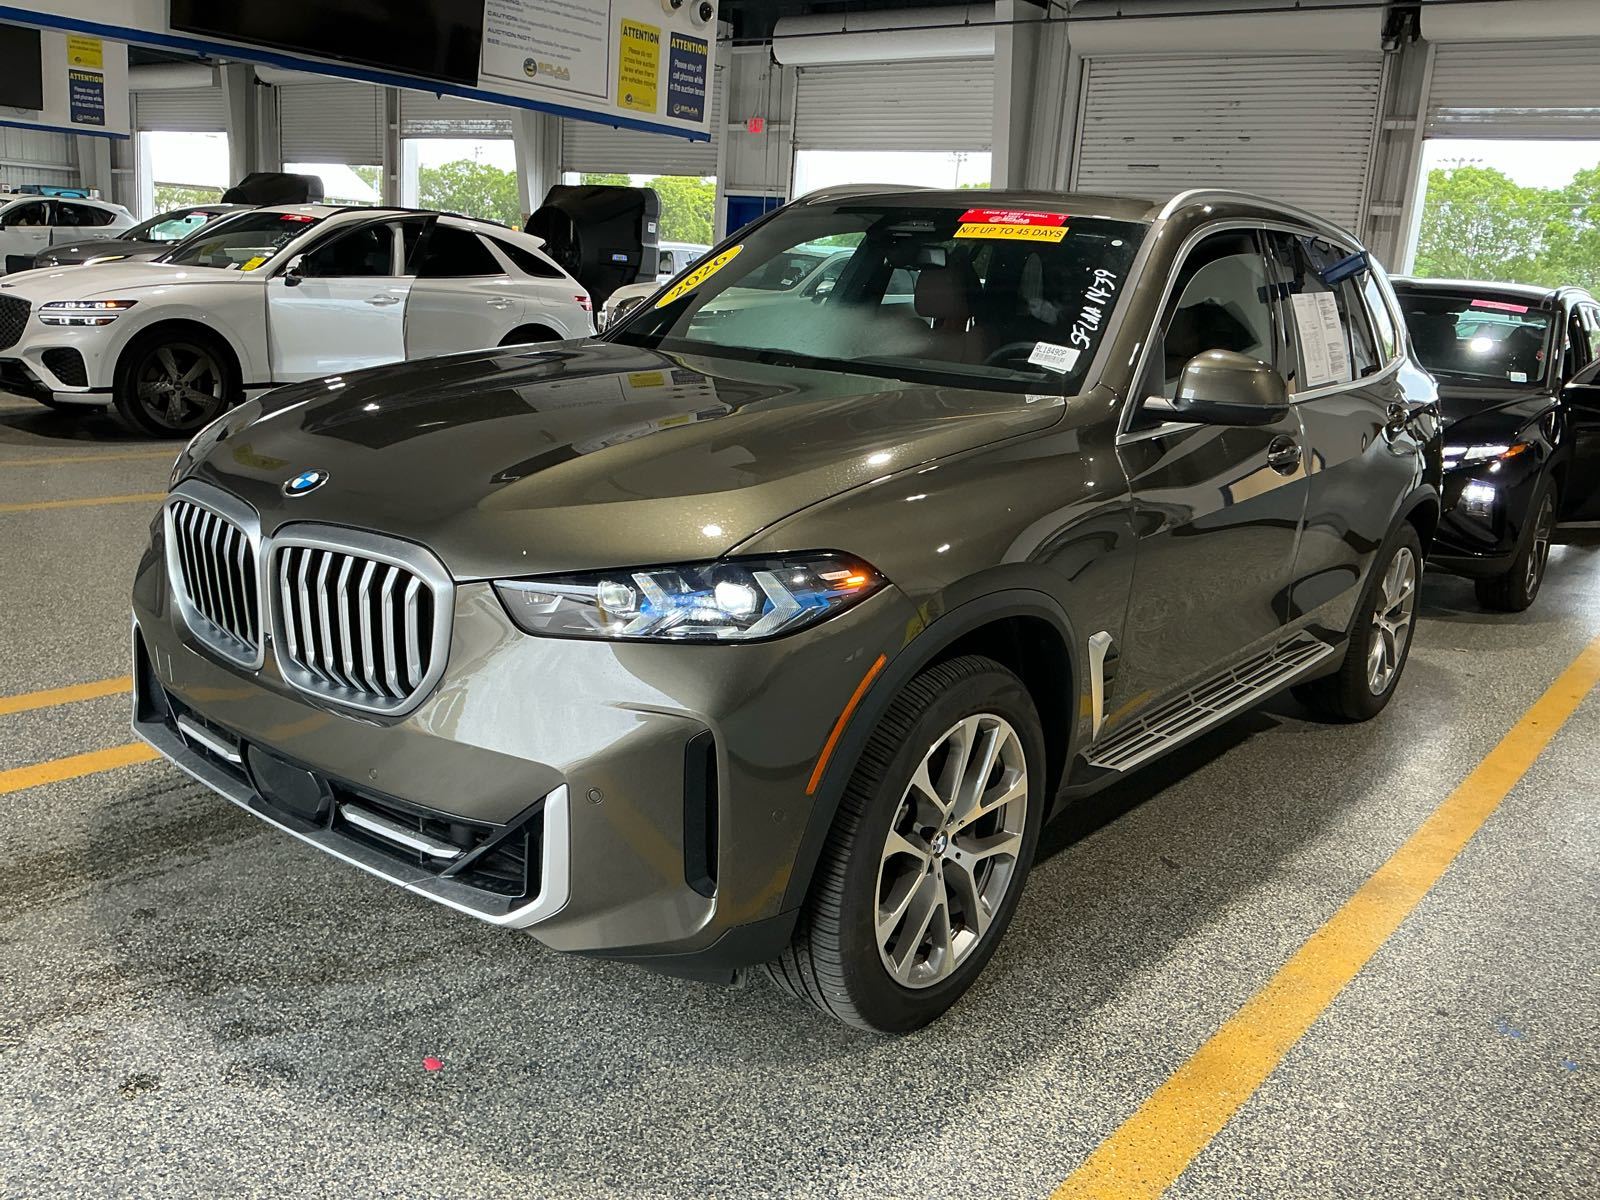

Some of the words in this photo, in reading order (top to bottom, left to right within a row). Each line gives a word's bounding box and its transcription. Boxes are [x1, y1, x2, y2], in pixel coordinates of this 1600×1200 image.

[623, 25, 659, 44] ATTENTION
[671, 38, 709, 55] ATTENTION
[674, 59, 687, 70] Please
[688, 63, 696, 73] stay
[70, 72, 104, 83] ATTENTION
[680, 74, 694, 83] phones
[694, 76, 704, 85] while
[681, 86, 694, 94] auction
[1000, 227, 1014, 235] TO
[1032, 229, 1063, 237] DAYS
[671, 256, 728, 297] 2026
